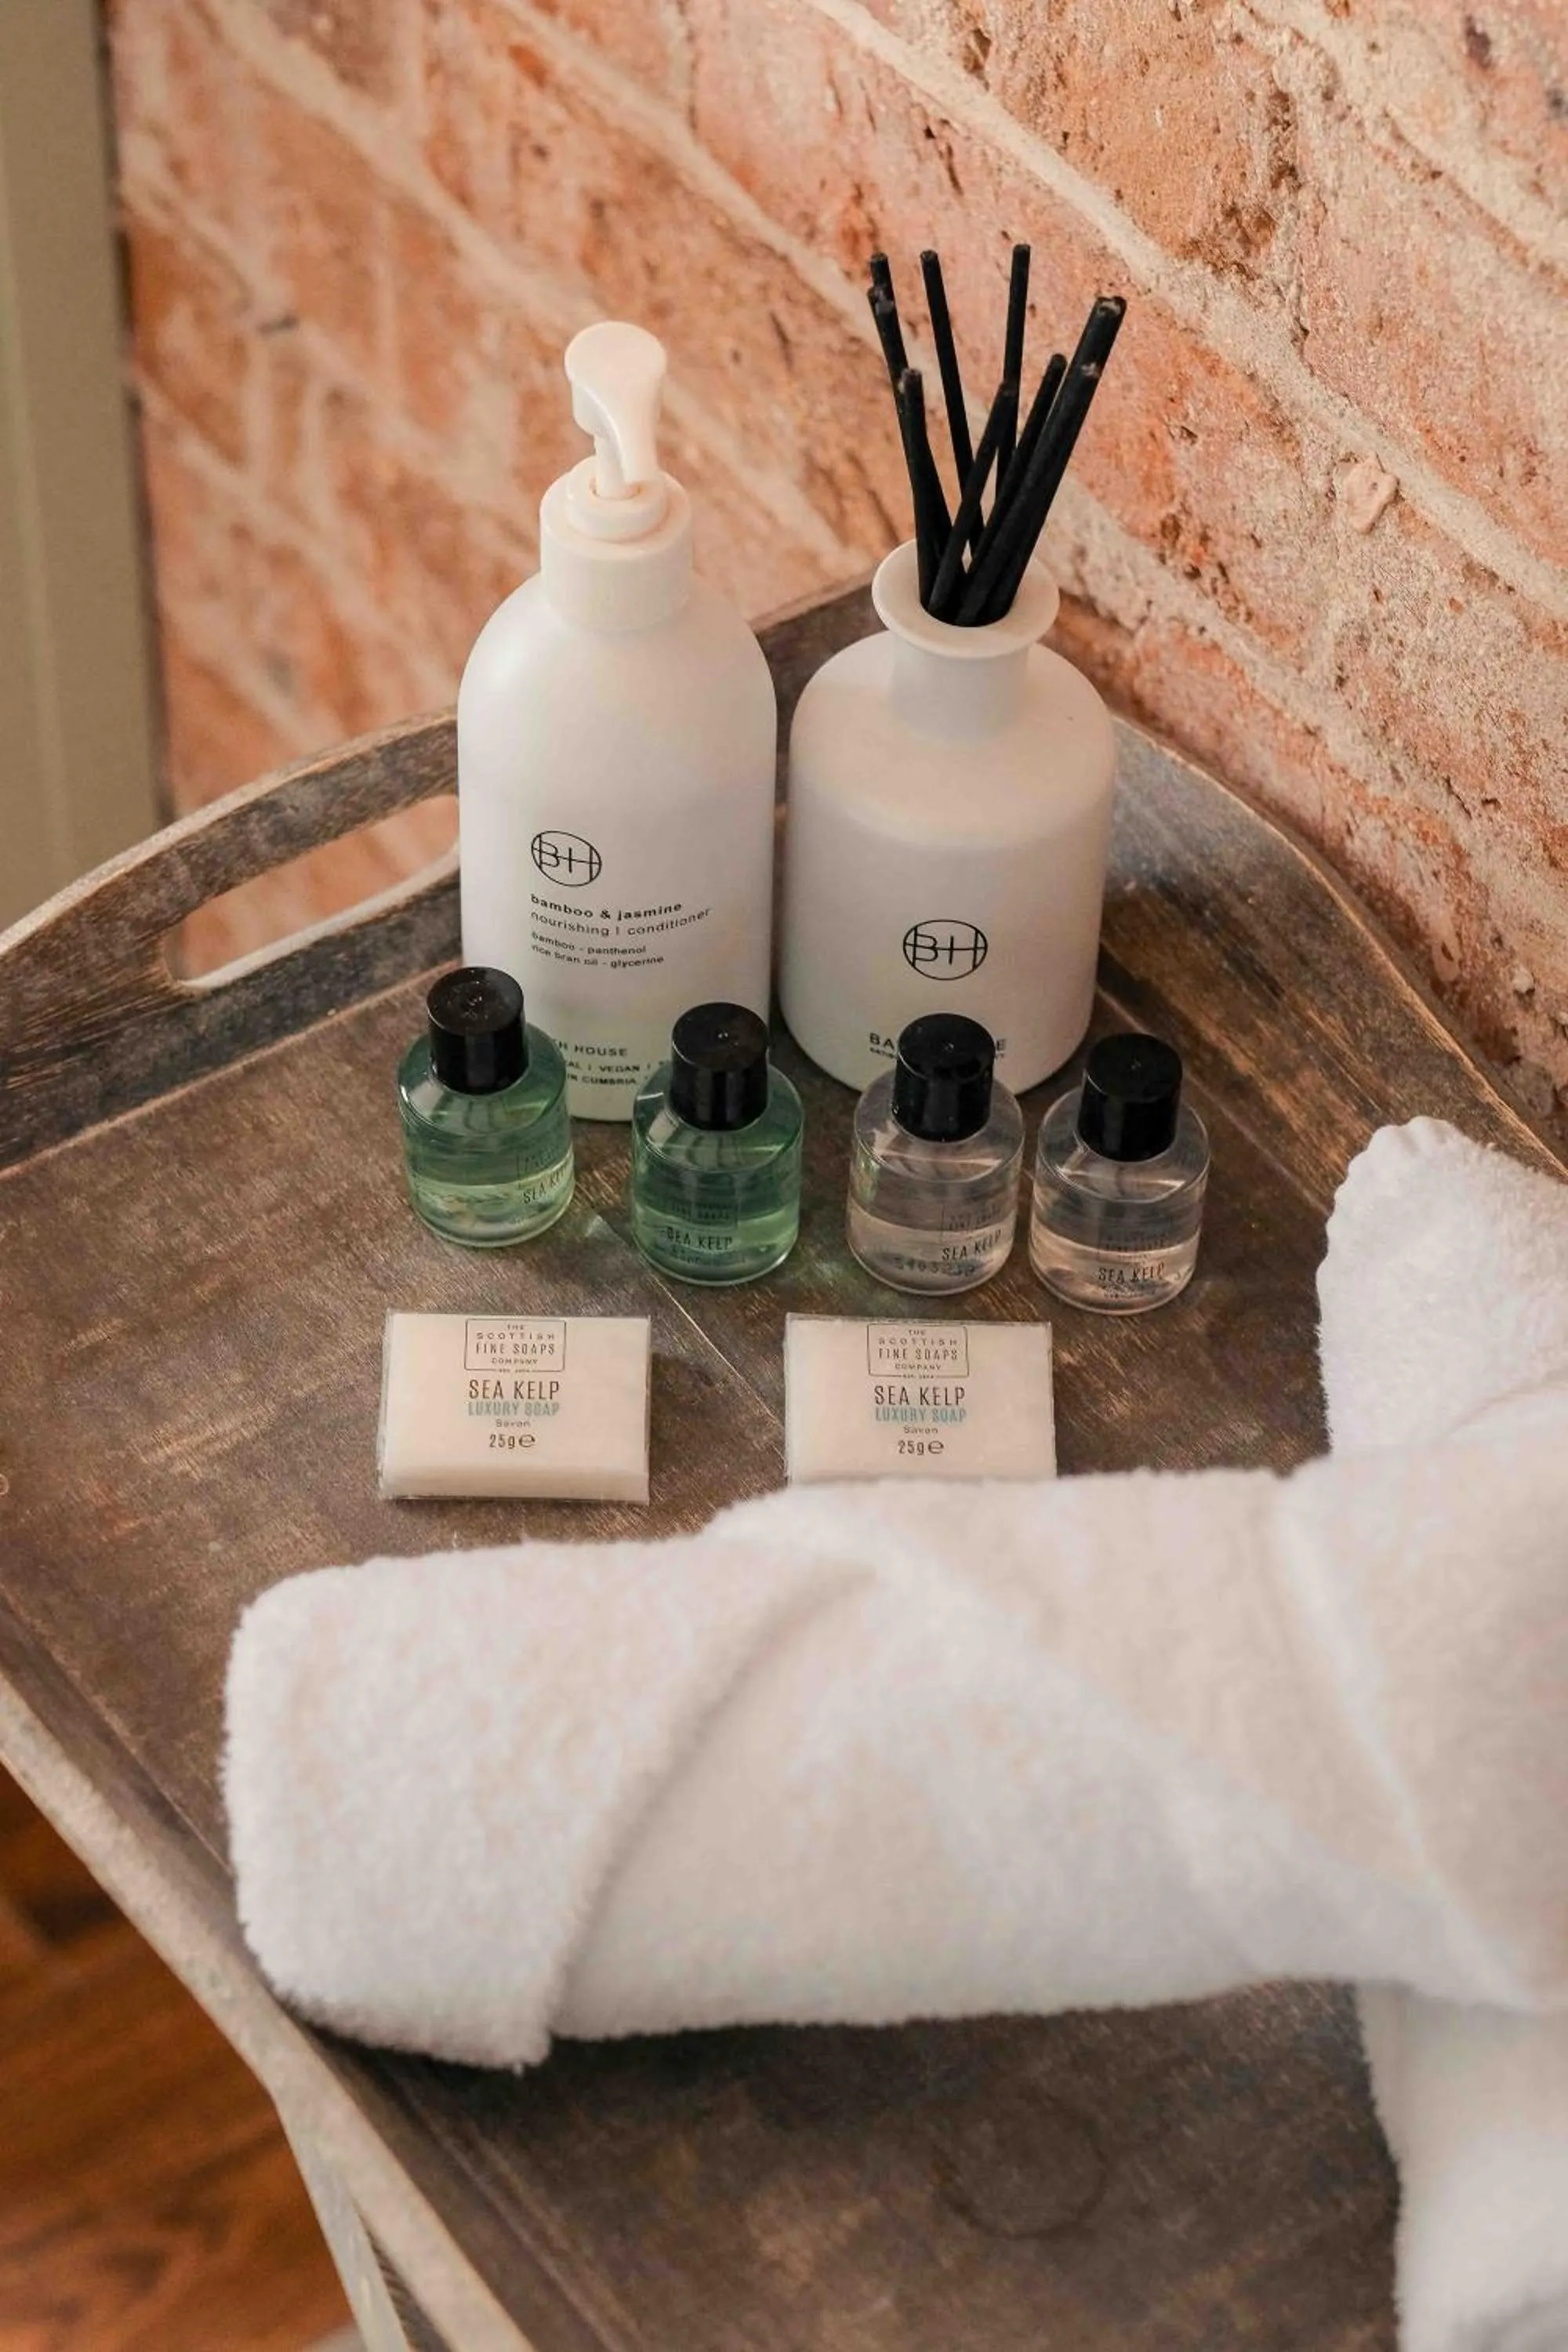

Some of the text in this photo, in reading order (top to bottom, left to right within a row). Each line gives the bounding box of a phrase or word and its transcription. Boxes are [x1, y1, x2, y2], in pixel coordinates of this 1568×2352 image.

[531, 894, 683, 921] bamboo & jasmine
[531, 911, 610, 937] nourishing
[627, 908, 711, 936] conditioner
[531, 931, 575, 951] bamboo
[588, 946, 647, 956] panthenol
[610, 956, 664, 969] glycerine
[575, 1044, 628, 1057] HOUSE
[582, 1076, 637, 1085] CUMBRIA
[476, 1343, 554, 1355] FINE SOAPS
[878, 1338, 957, 1346] SCOTTISH
[879, 1348, 957, 1360] FINE SOAPS
[469, 1378, 559, 1400] SEA KELP
[874, 1385, 965, 1406] SEA KELP
[468, 1402, 560, 1416] LUXURY SOAP
[876, 1407, 967, 1423] LUXURY SOAP
